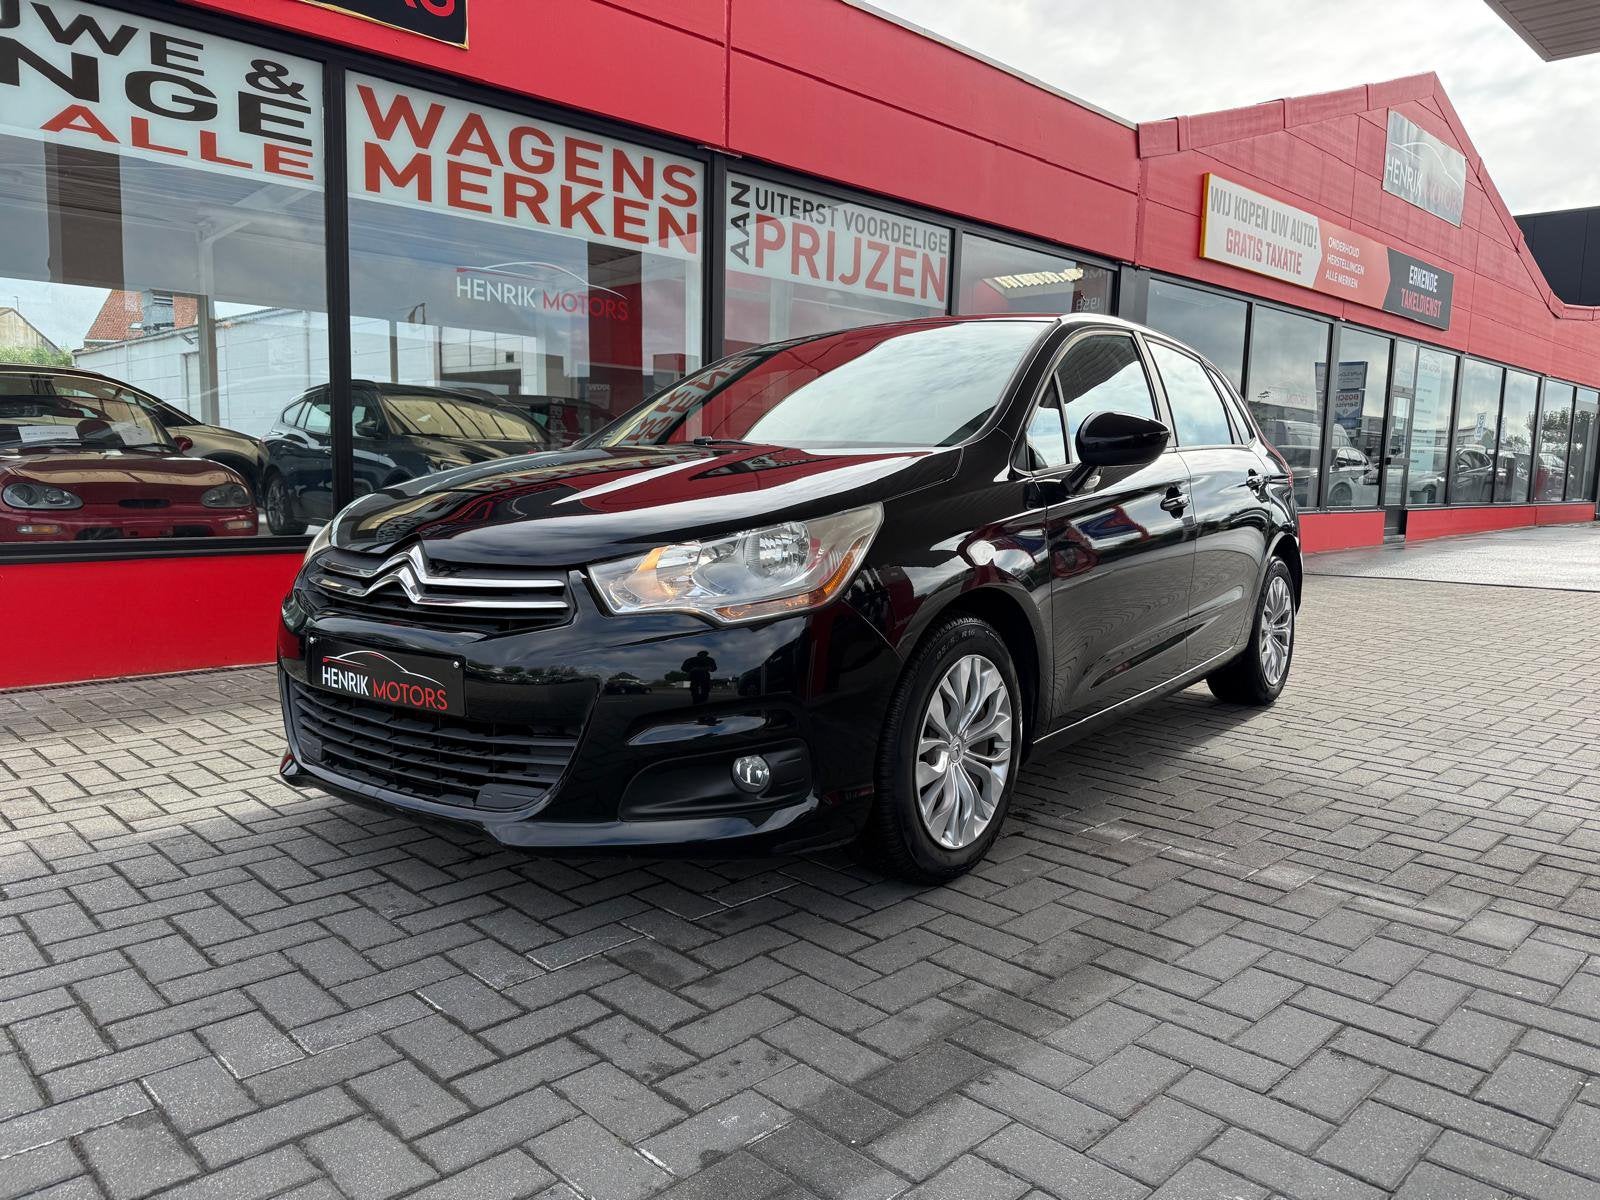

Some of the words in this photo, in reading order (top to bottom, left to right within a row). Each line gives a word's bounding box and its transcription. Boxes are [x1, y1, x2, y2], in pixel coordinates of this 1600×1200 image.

[0, 0, 205, 76] WE
[245, 59, 308, 101] &
[40, 104, 314, 181] ALLE
[357, 84, 698, 208] WAGENS
[1386, 154, 1422, 197] HENRIK
[364, 141, 698, 254] MERKEN
[730, 181, 751, 265] AAN
[755, 187, 838, 227] UITERST
[843, 210, 948, 254] VOORDELIGE
[1210, 186, 1232, 217] WIJ
[1233, 195, 1269, 231] KOPEN
[1271, 210, 1289, 237] UW
[1290, 218, 1318, 249] AUTO!
[754, 213, 947, 303] PRIJZEN
[1225, 228, 1263, 262] GRATIS
[1266, 242, 1303, 275] TAXATIE
[1409, 265, 1438, 293] ERKENDE
[456, 276, 536, 308] HENRIK
[542, 290, 629, 321] MOTORS
[322, 666, 369, 697] HENRIK
[373, 678, 449, 711] MOTORS
